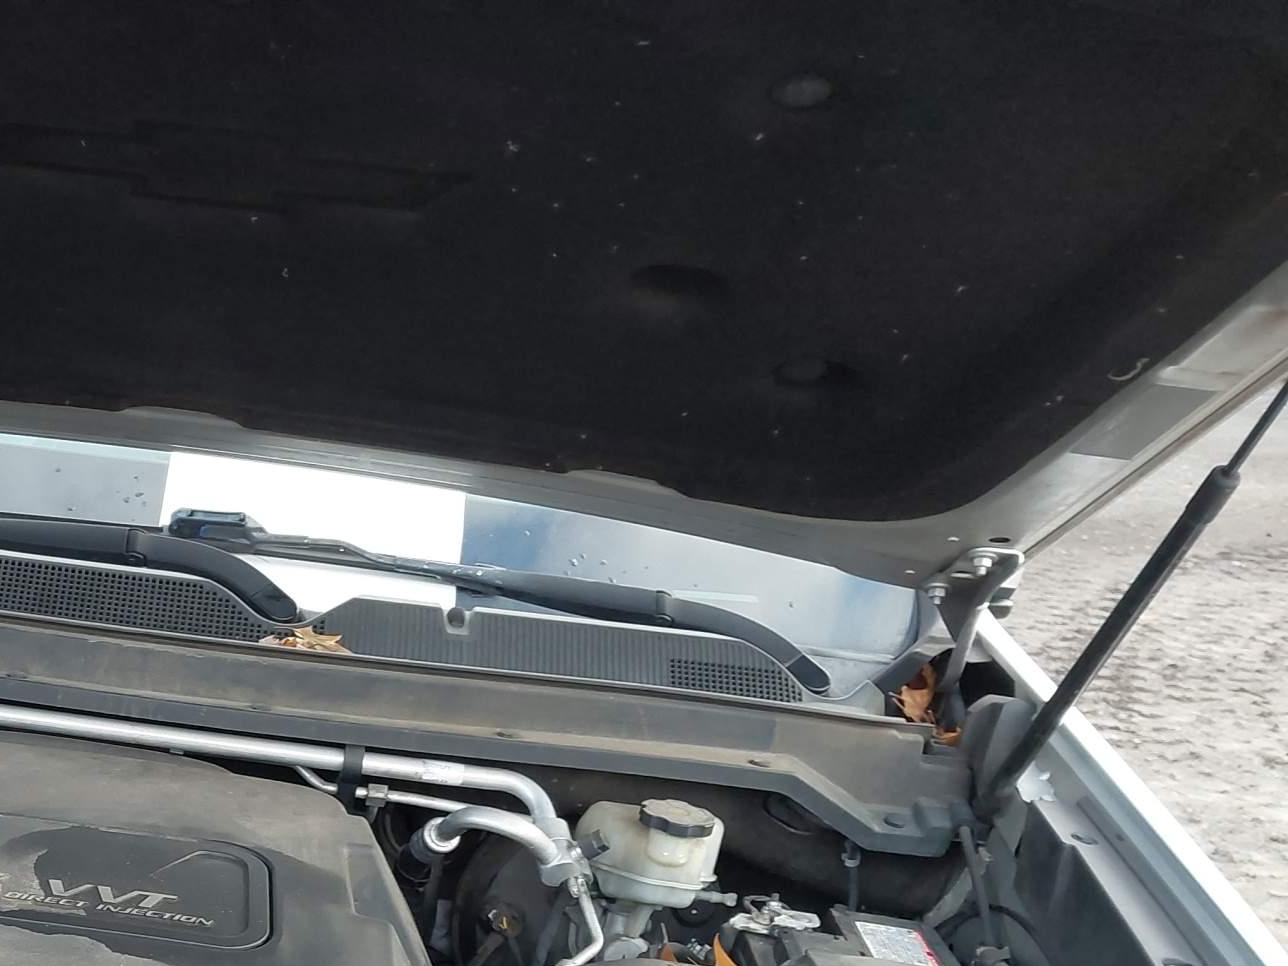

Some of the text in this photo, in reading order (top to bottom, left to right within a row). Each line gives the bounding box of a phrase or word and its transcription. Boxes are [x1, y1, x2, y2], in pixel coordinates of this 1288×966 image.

[3, 890, 215, 928] DIRECT INJECTION
[48, 879, 178, 908] VVT
